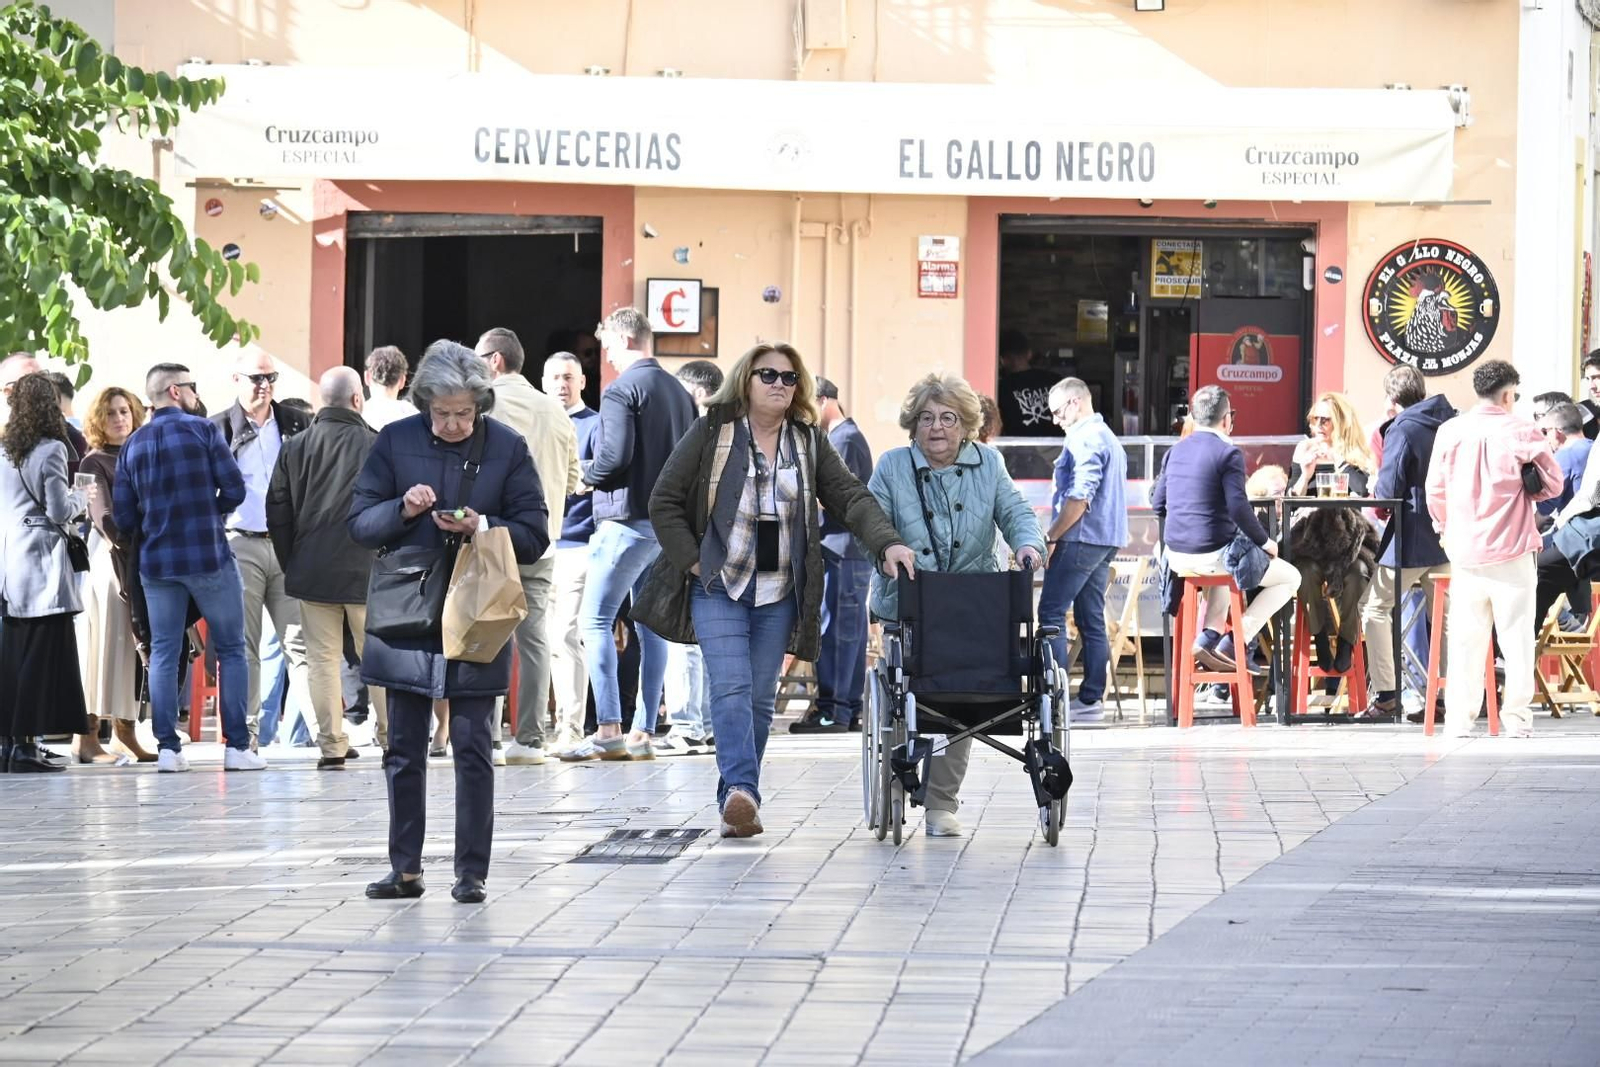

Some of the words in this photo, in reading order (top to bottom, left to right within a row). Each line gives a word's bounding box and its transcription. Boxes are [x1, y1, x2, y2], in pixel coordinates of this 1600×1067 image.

[265, 125, 379, 147] Cruzcampo
[474, 126, 681, 171] CERVECERIAS
[282, 150, 361, 164] ESPECIAL
[899, 138, 933, 179] EL
[946, 139, 1041, 181] GALLO
[1056, 141, 1155, 183] NEGRO
[1245, 145, 1360, 169] Cruzcampo
[1261, 171, 1341, 185] ESPECIAL
[1378, 266, 1396, 284] EL
[1396, 246, 1440, 267] GLLO
[1445, 248, 1485, 284] NEGRO
[1379, 331, 1419, 368] PLAZA
[1441, 331, 1484, 368] MONJAS
[1221, 367, 1279, 380] Cruzcampo
